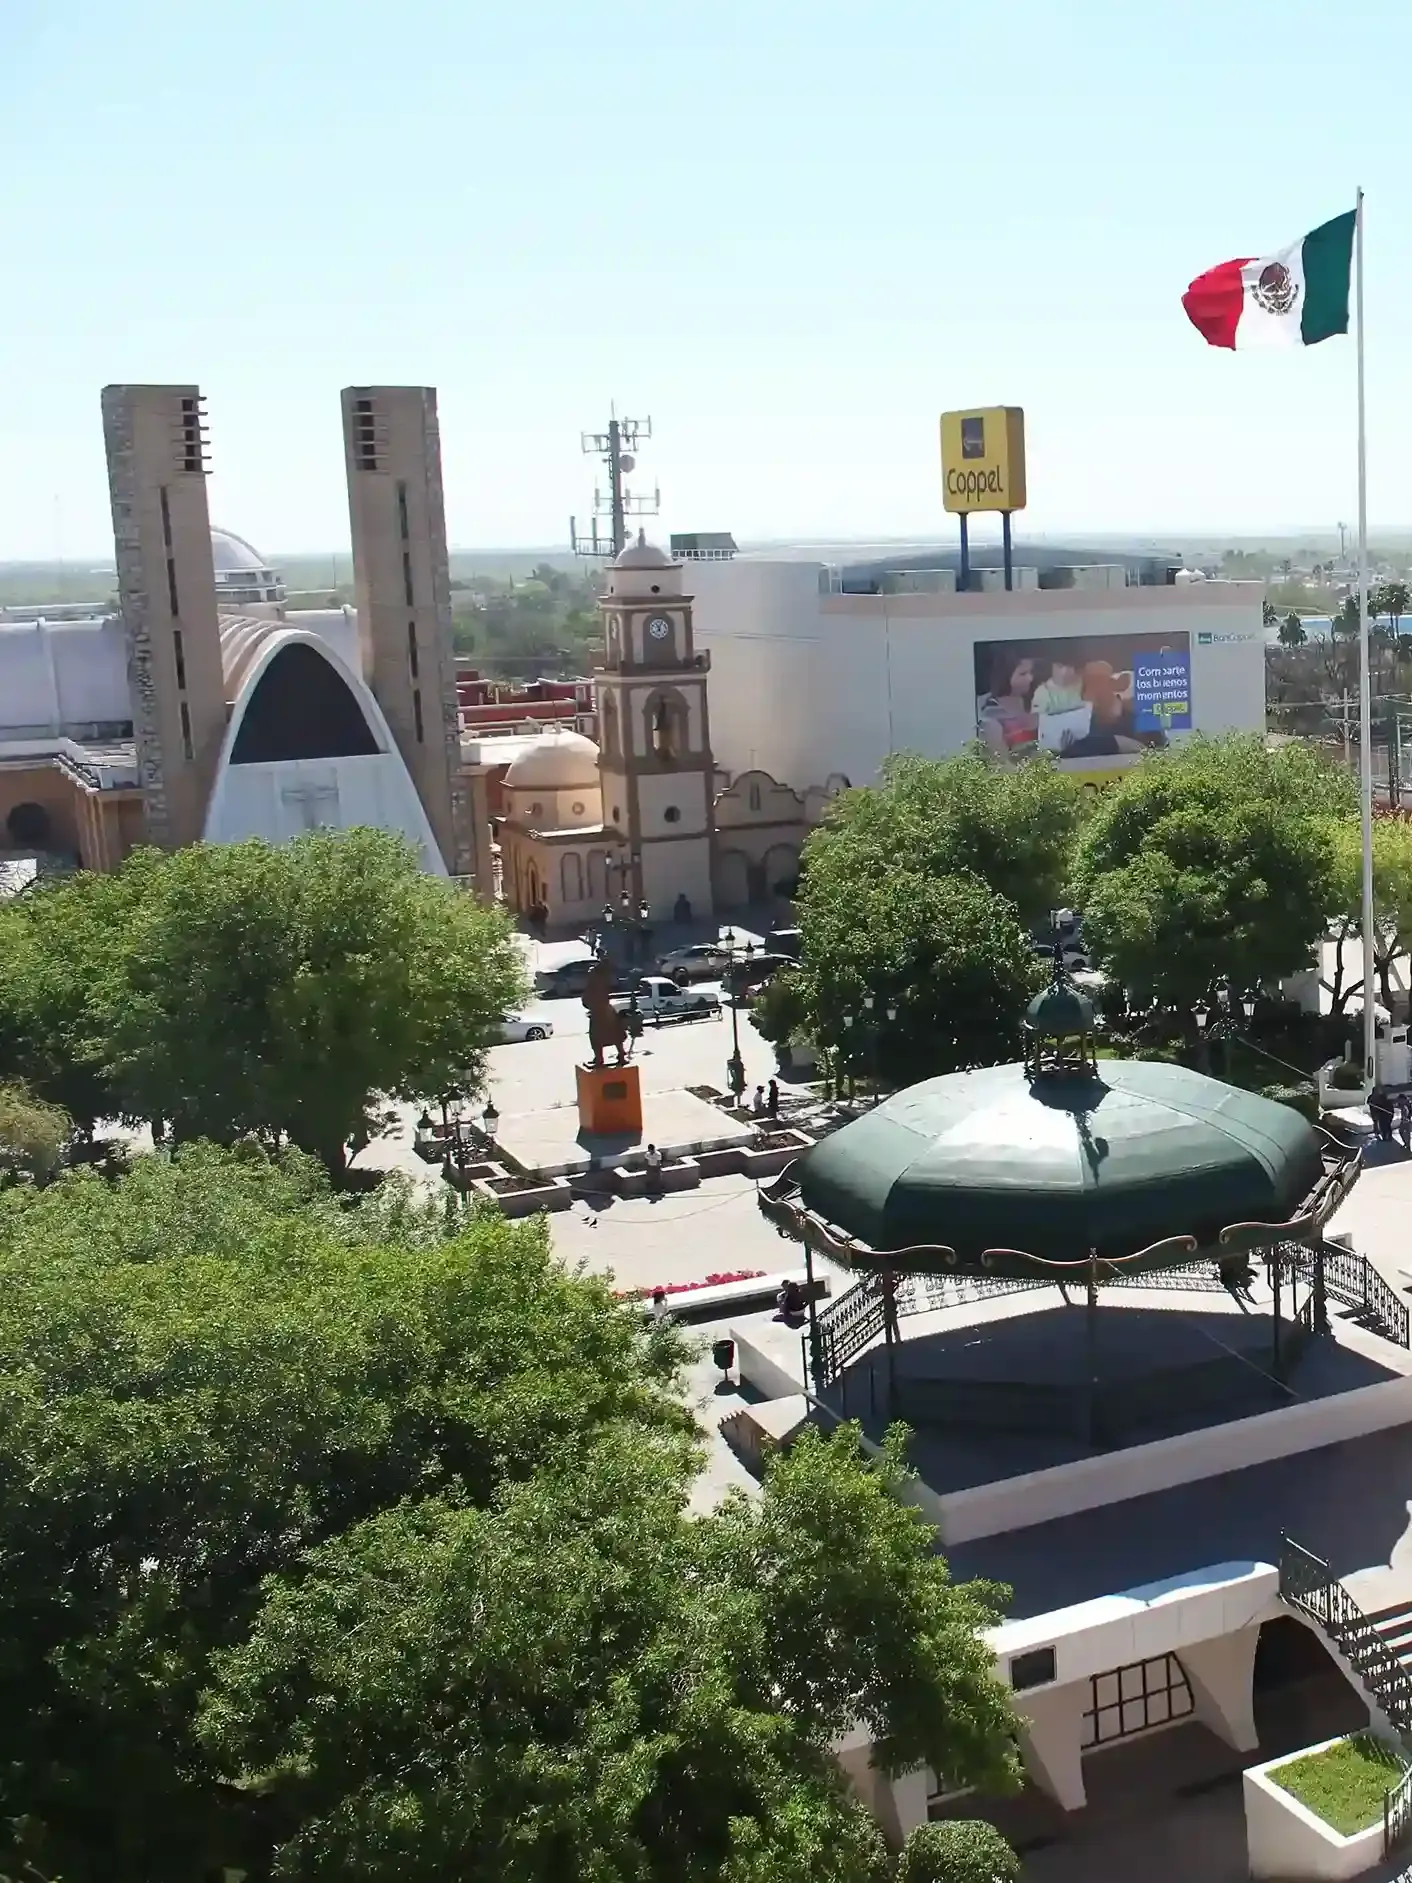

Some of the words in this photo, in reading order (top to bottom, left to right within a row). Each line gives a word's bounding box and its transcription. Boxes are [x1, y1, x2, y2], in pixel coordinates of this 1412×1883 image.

[947, 465, 1004, 502] Coppel
[1136, 679, 1152, 689] los
[1137, 689, 1188, 701] momentos
